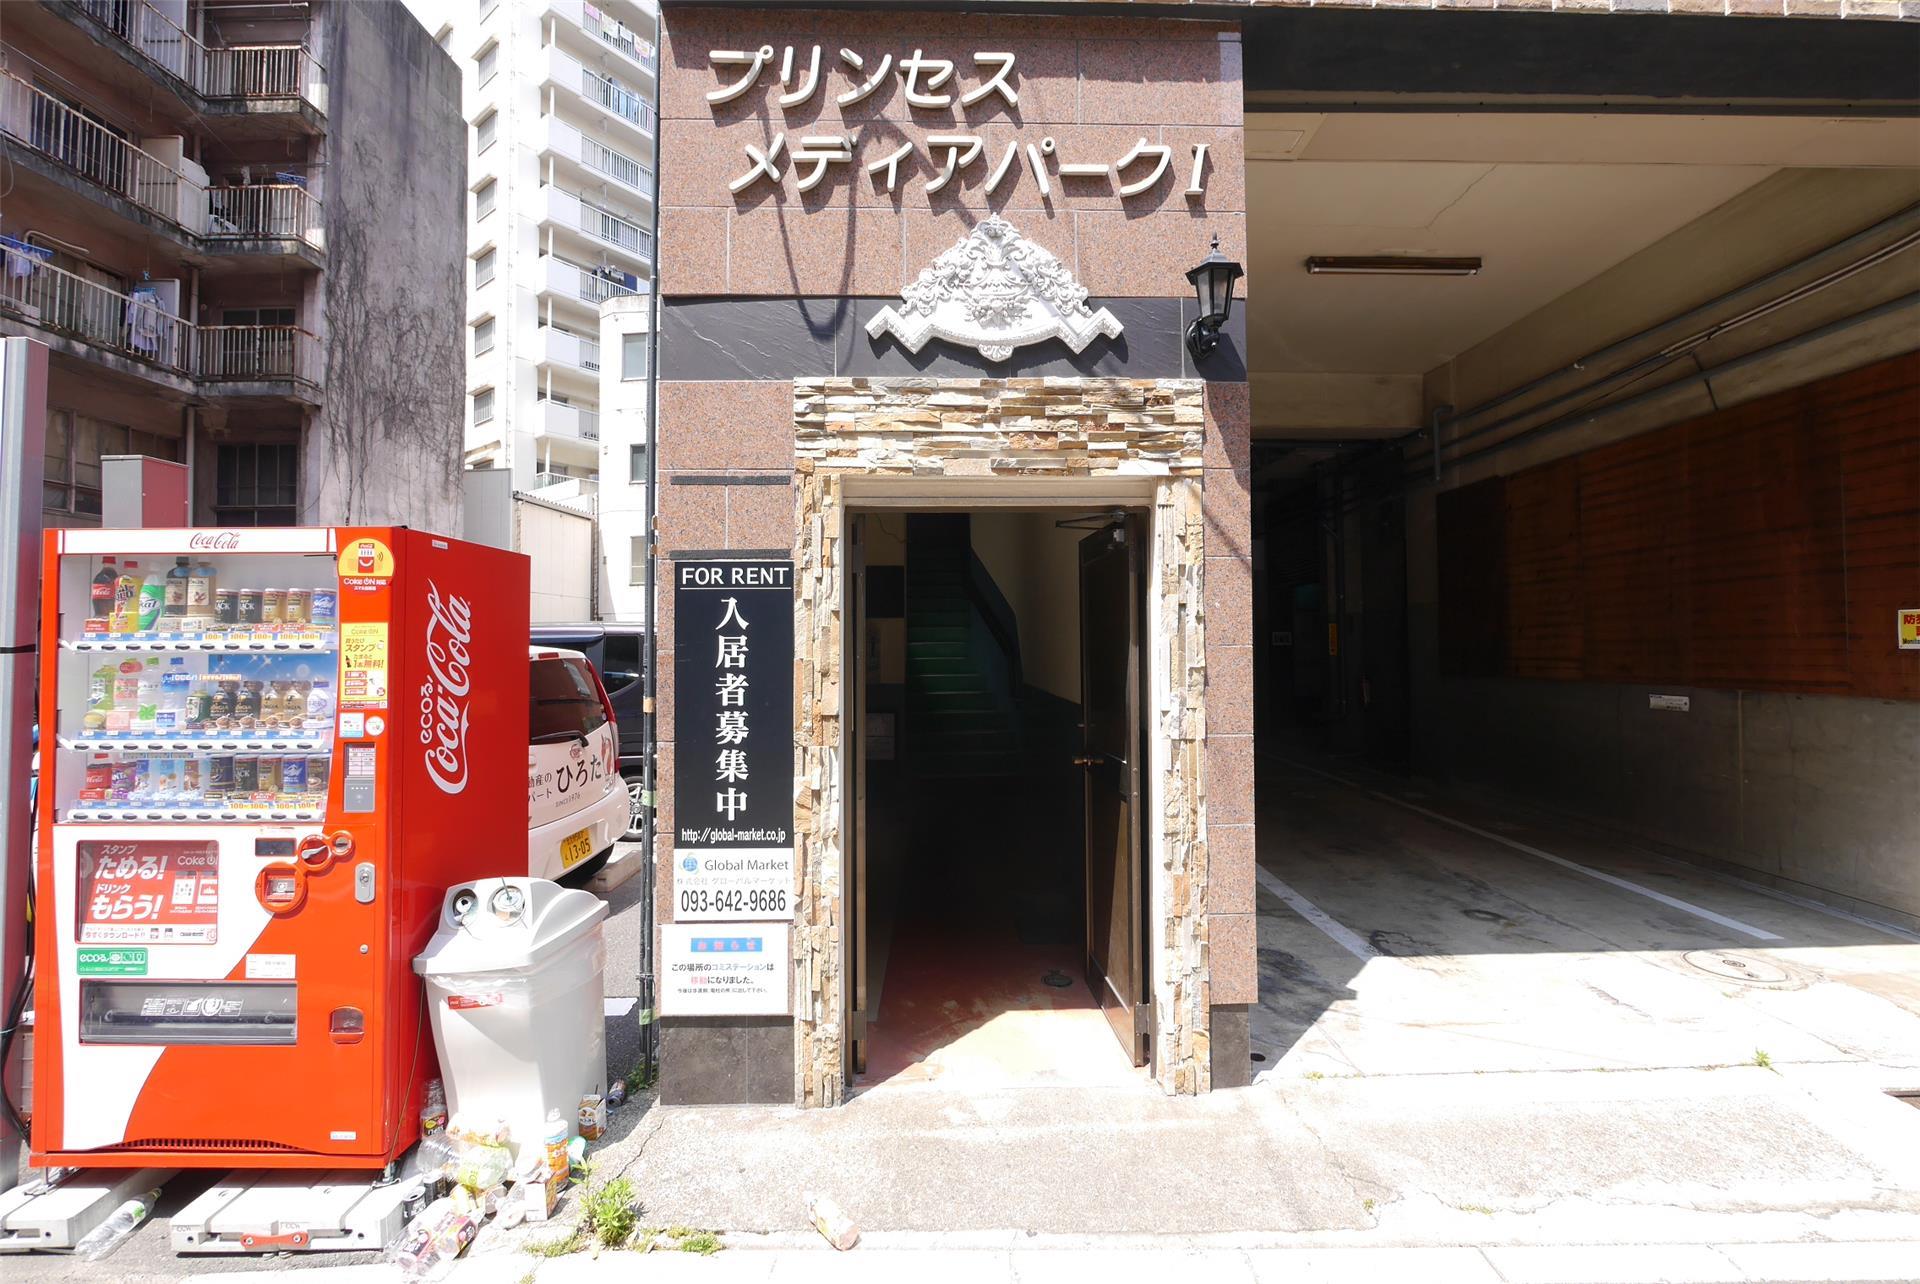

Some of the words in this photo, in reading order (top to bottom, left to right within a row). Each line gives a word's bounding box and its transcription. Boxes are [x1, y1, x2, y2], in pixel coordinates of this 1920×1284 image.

[706, 45, 1018, 108] プリンセス
[682, 567, 725, 585] FOR
[731, 567, 790, 585] RENT
[715, 597, 749, 821] 入居者募集中
[556, 754, 602, 793] ひろた
[101, 845, 138, 855] スタンプ
[177, 855, 205, 866] Coke
[95, 855, 168, 880] ためる!
[704, 860, 743, 871] Global
[748, 859, 788, 870] Market
[95, 883, 132, 894] ドリンク
[91, 894, 164, 920] もらう!
[681, 890, 786, 911] 093-642-9686
